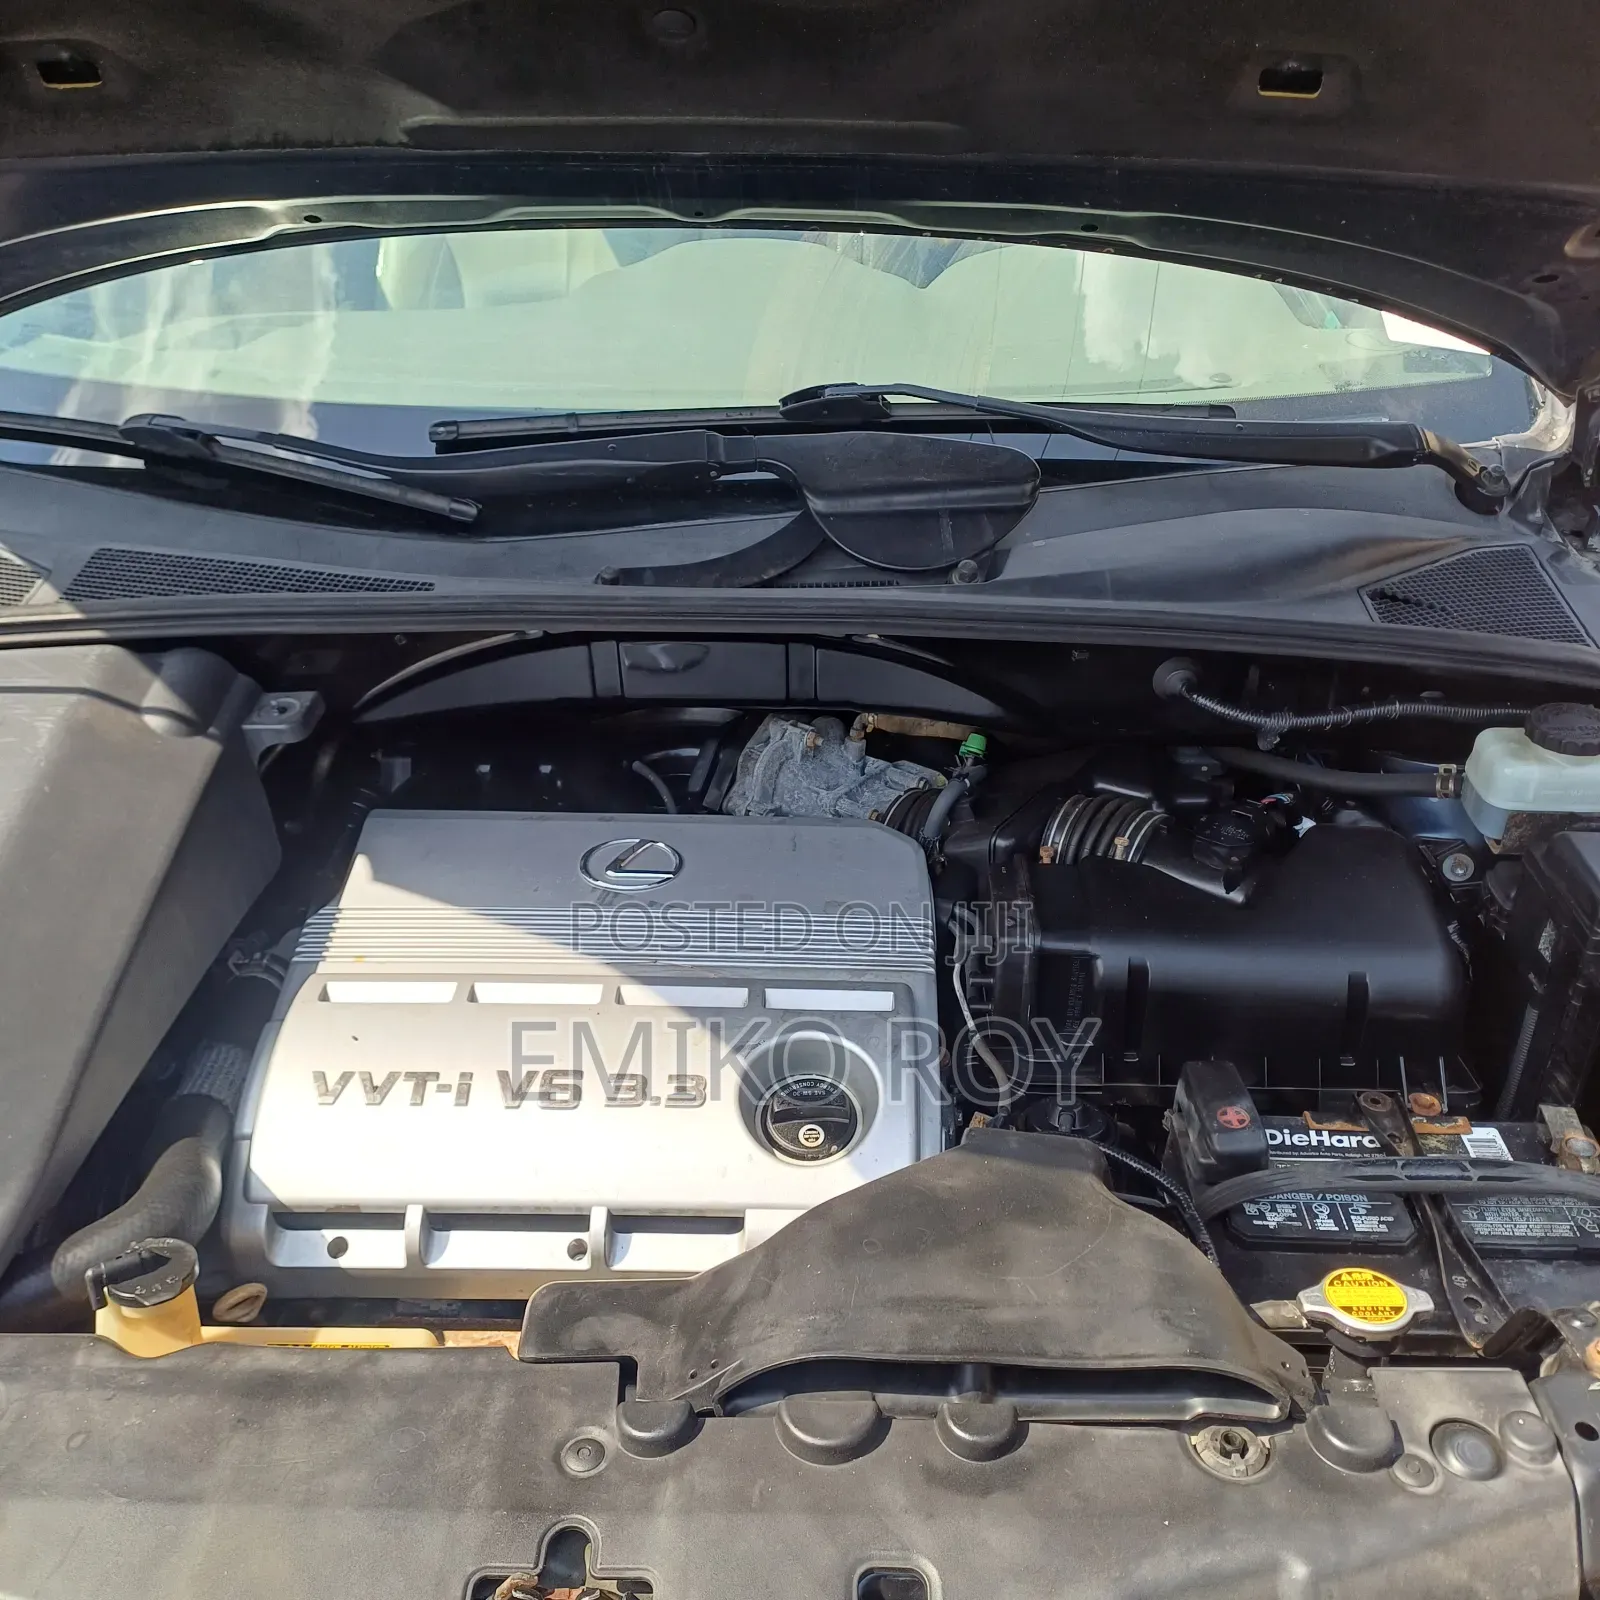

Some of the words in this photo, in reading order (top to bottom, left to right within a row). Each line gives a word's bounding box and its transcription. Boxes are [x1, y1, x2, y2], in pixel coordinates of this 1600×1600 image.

[496, 1069, 585, 1110] V6
[603, 1072, 709, 1109] 3.3
[1326, 1193, 1369, 1202] POISON
[1333, 1279, 1389, 1287] CAUTION
